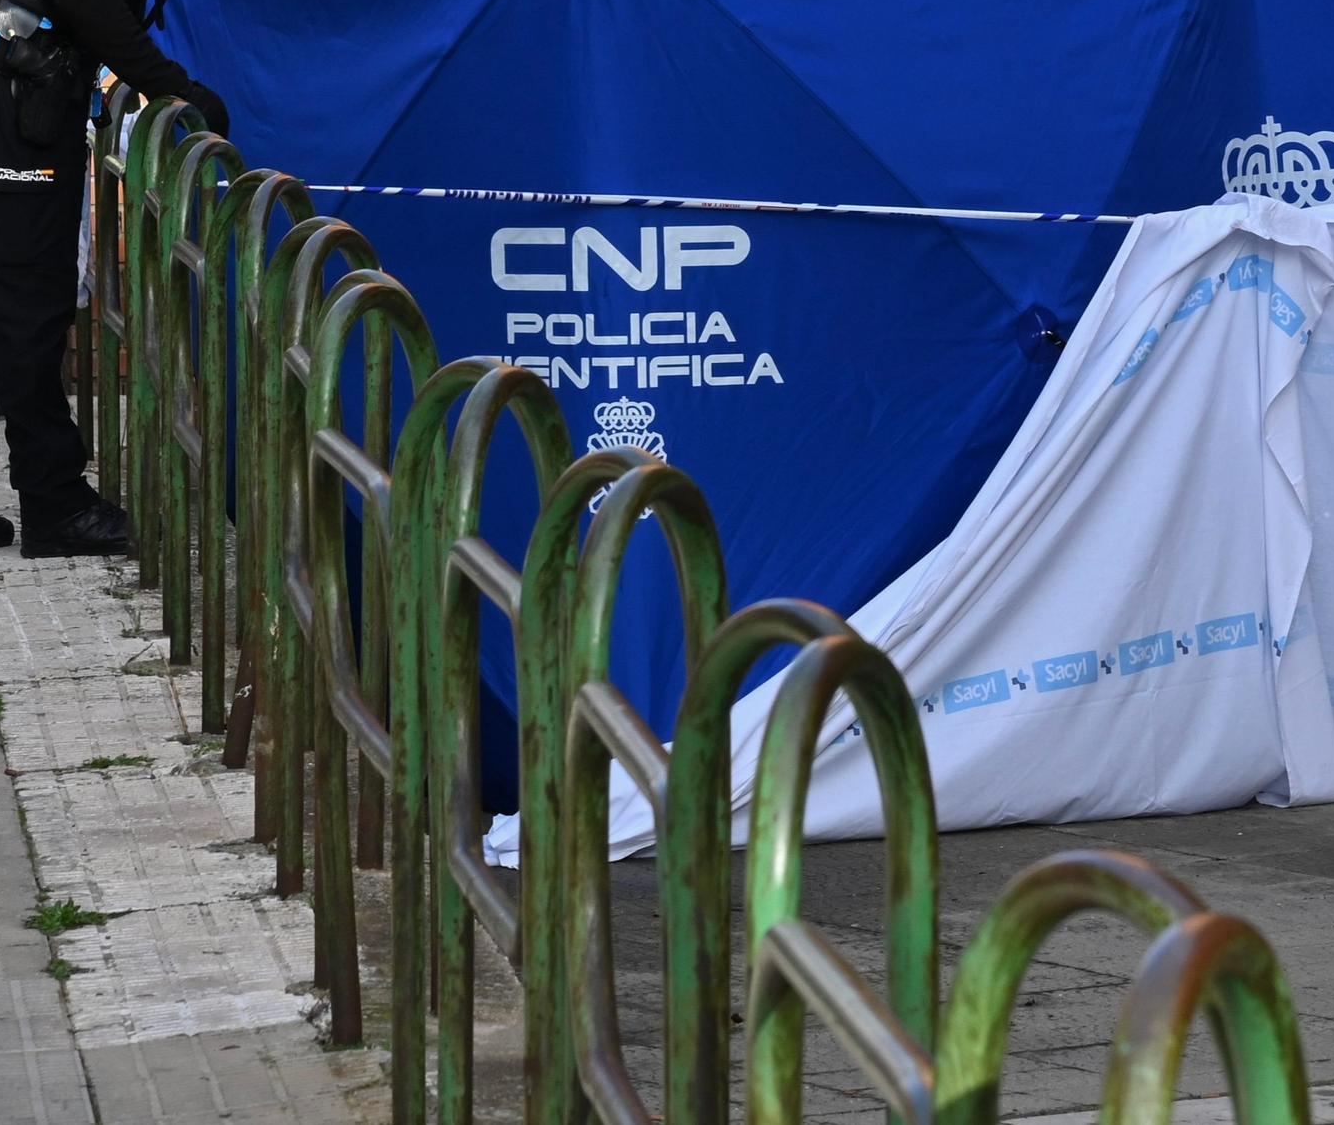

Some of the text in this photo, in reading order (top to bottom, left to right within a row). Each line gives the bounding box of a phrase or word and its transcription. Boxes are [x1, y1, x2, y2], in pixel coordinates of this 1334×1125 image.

[490, 225, 751, 292] CNP
[506, 311, 736, 345] POLICIA
[472, 352, 784, 390] ENTIFICA
[953, 620, 1246, 704] Sacyl Sacyl Sacyl Sacyl
